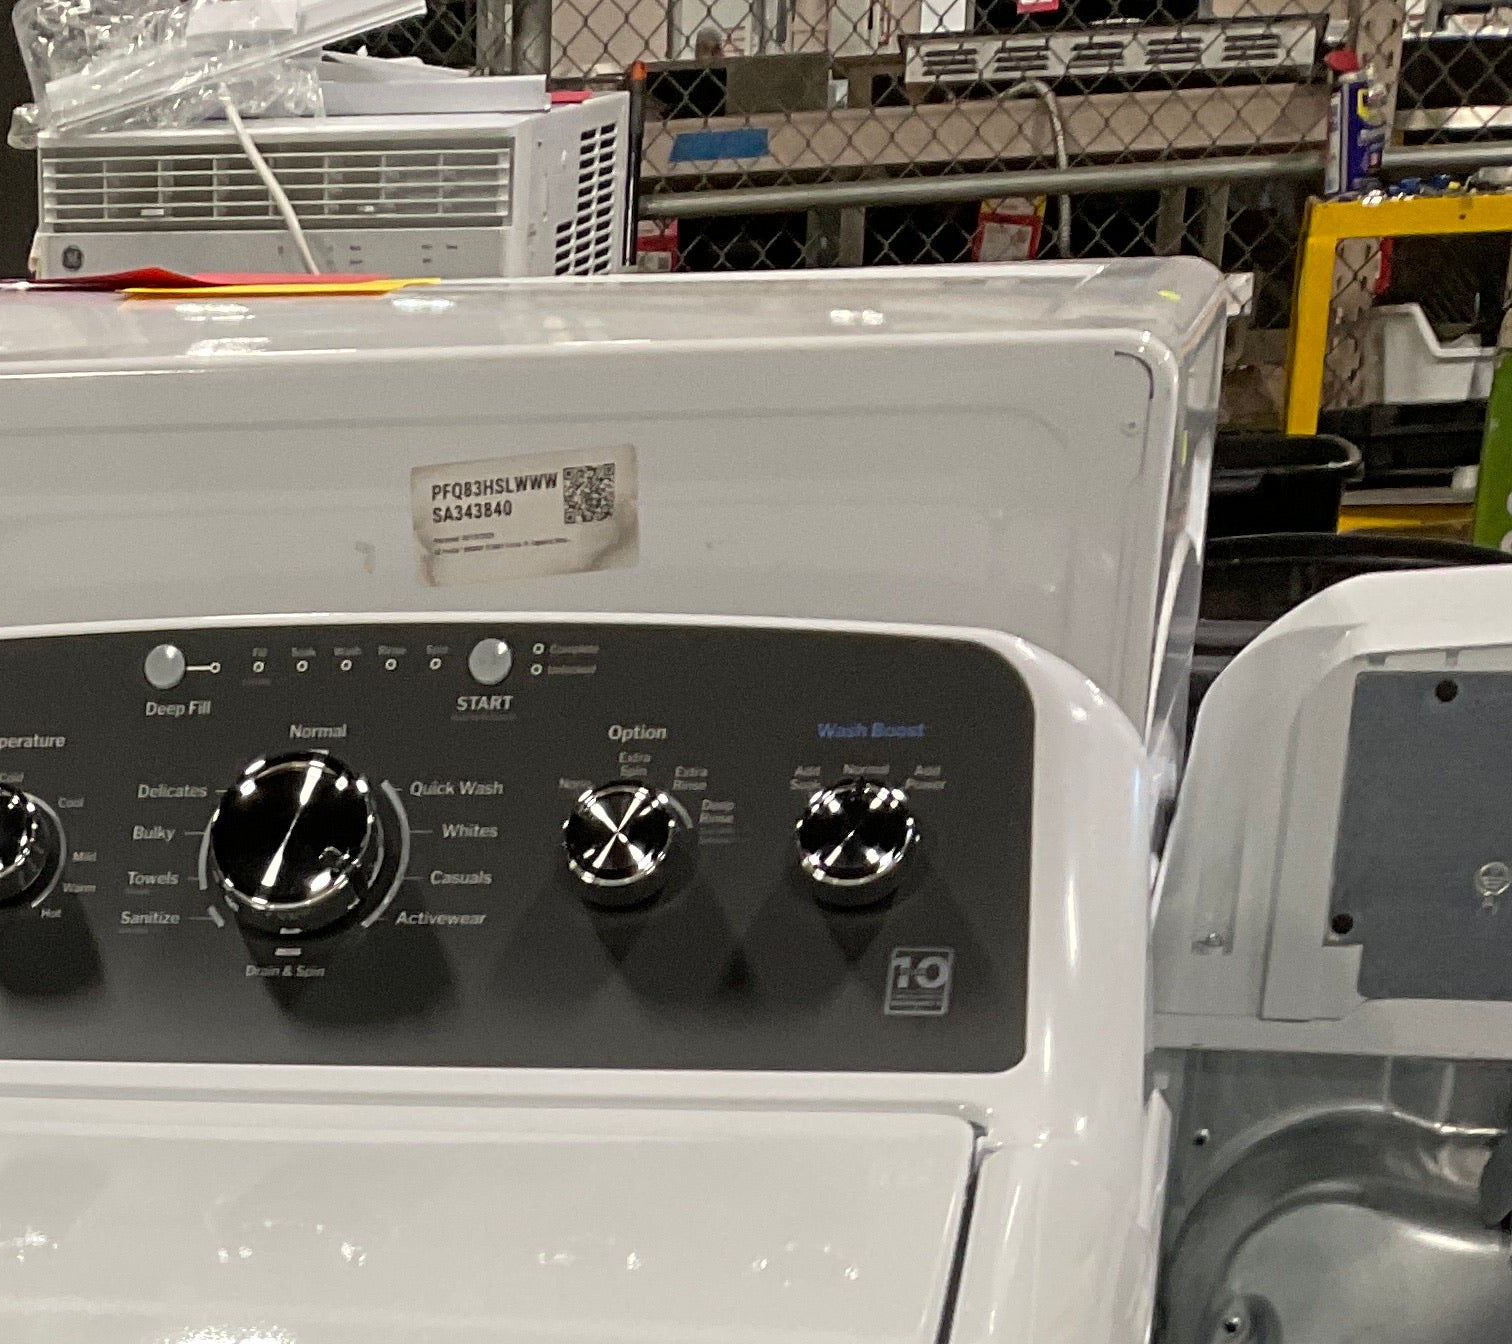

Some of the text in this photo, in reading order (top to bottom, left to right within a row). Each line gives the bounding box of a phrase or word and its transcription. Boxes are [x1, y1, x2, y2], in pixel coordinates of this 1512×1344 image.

[145, 700, 211, 718] Deep Fill
[455, 695, 514, 711] START
[289, 723, 347, 739] Normal
[607, 724, 667, 743] Option
[137, 783, 208, 800] Delicates
[409, 780, 504, 797] Quick Wash
[132, 825, 175, 842] Bulky
[442, 823, 499, 839] Whites
[127, 870, 180, 886] Towels
[430, 870, 493, 886] Casuals
[120, 910, 181, 926] Sanitize
[395, 911, 487, 926] Activewear
